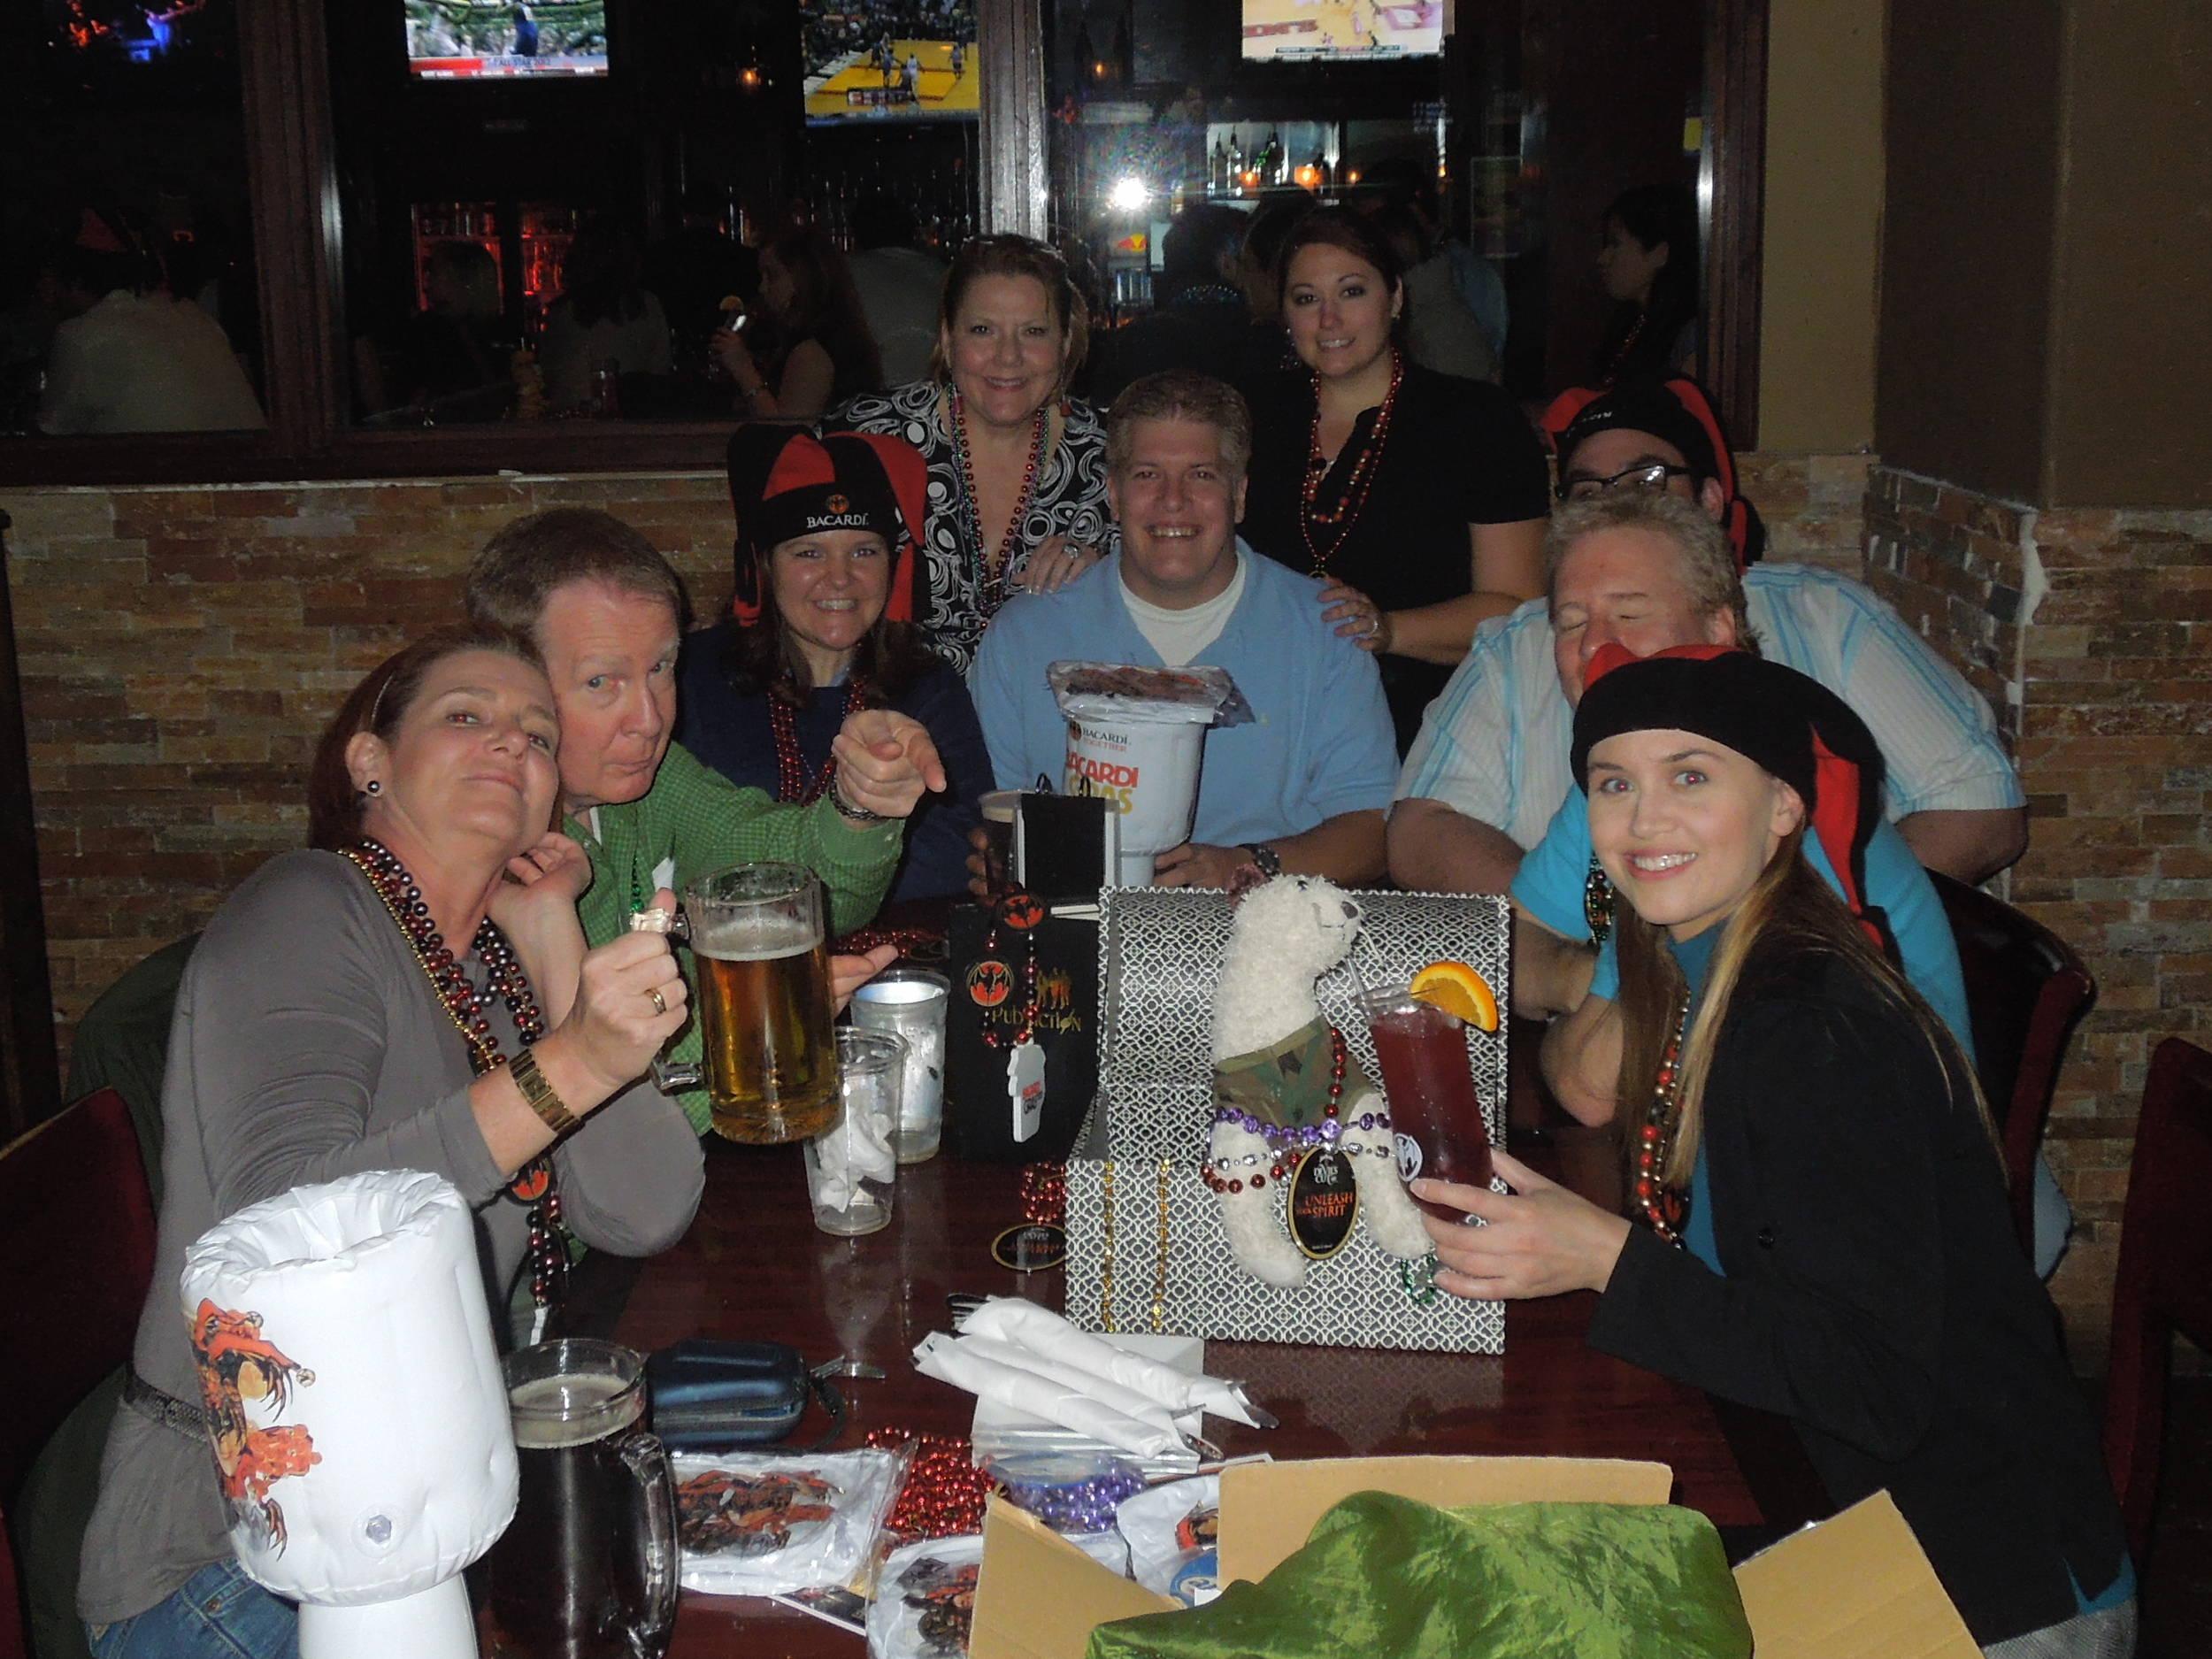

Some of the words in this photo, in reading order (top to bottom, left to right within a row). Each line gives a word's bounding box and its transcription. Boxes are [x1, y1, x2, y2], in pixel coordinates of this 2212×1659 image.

[1065, 751, 1140, 789] ACARDI
[1304, 1192, 1354, 1207] UNLEASH
[1312, 1204, 1346, 1218] SPIRIT
